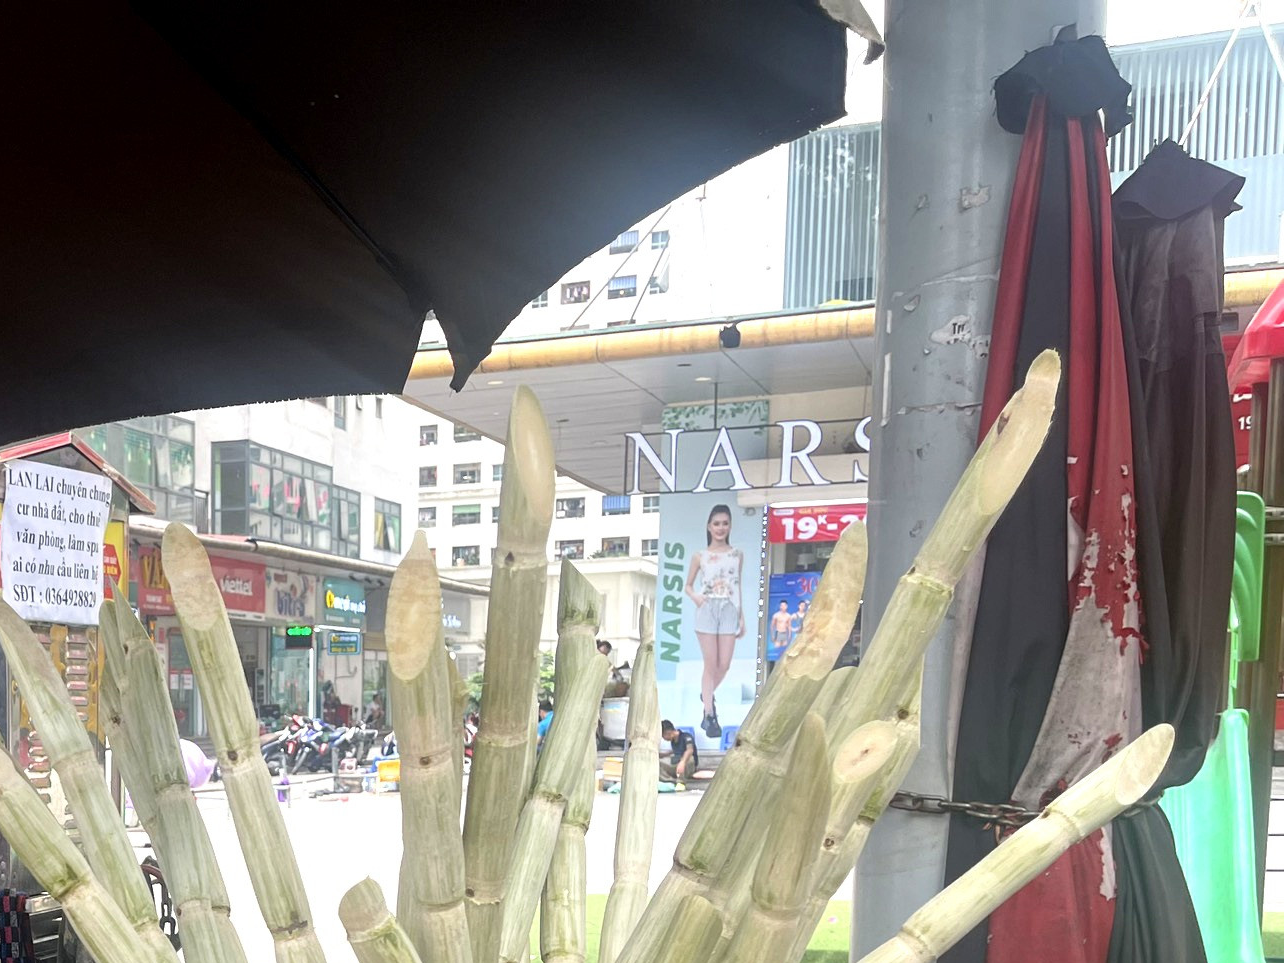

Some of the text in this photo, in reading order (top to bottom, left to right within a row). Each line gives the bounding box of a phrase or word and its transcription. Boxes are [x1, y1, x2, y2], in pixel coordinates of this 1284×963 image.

[9, 470, 33, 488] LAN
[35, 475, 54, 493] LAI
[56, 478, 88, 501] chuyên
[16, 502, 31, 515] cư
[31, 500, 49, 519] nhà
[68, 508, 85, 523] cho
[16, 527, 36, 546] văn
[67, 534, 85, 552] làm
[12, 556, 23, 573] ai
[25, 557, 37, 574] có
[38, 558, 55, 577] nhu
[56, 556, 72, 578] cầu
[73, 560, 89, 580] liên
[13, 583, 36, 603] SĐT
[660, 541, 685, 663] NARSIS
